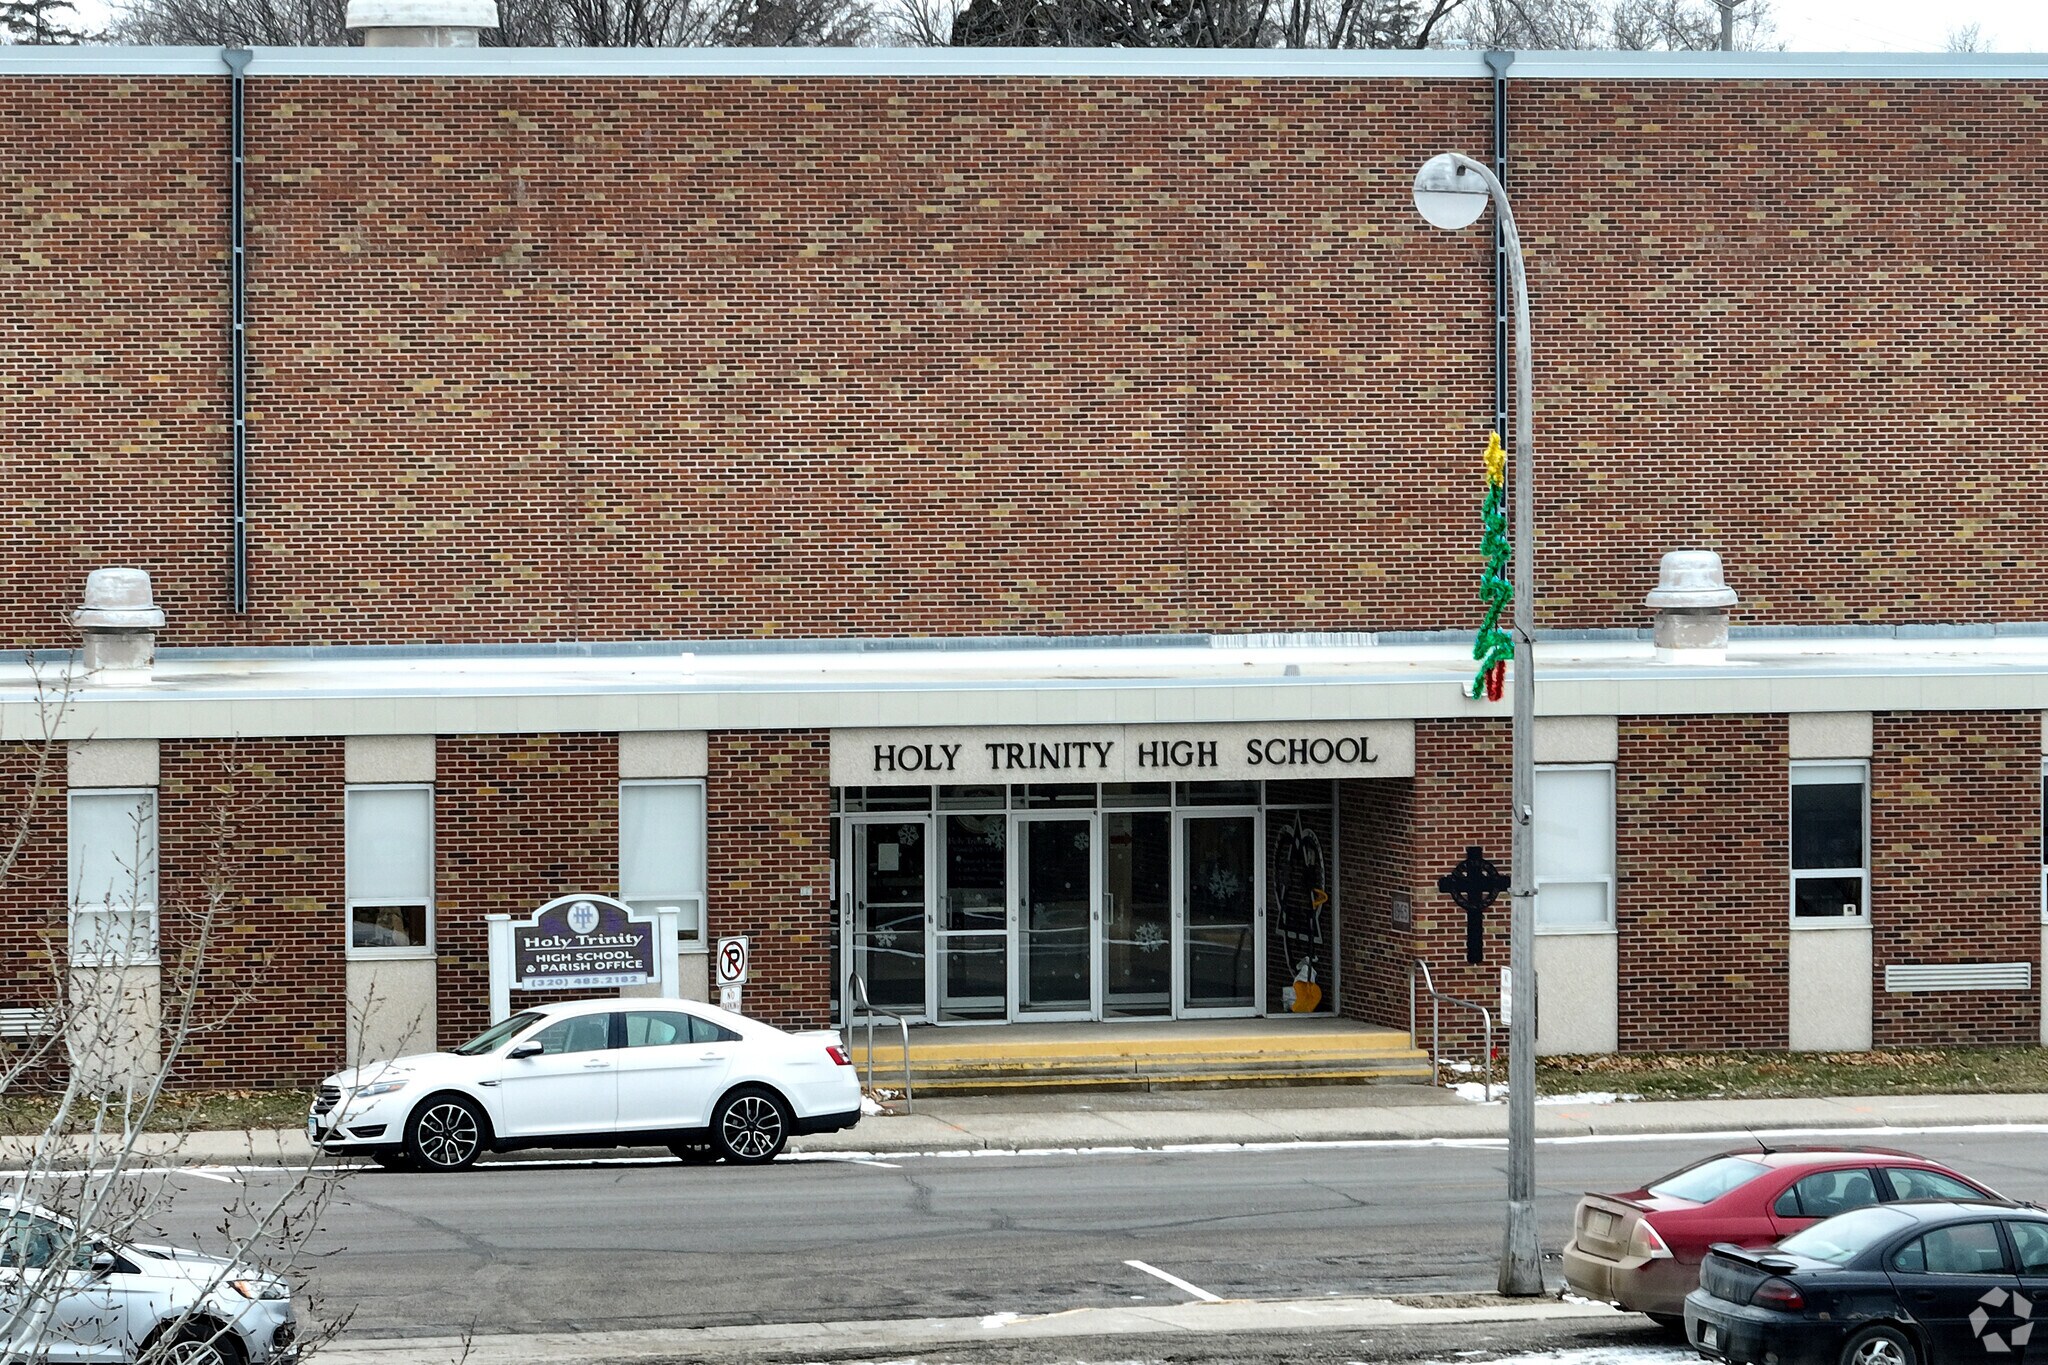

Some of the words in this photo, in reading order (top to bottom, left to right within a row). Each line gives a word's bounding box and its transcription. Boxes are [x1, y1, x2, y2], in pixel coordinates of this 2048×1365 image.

[873, 744, 962, 772] HOLY
[985, 741, 1114, 770] TRINITY
[1138, 740, 1218, 768] HIGH
[1246, 736, 1379, 765] SCHOOL
[523, 935, 572, 950] Holy
[575, 932, 643, 947] Trinity
[535, 953, 572, 963] HIGH
[575, 950, 634, 961] SCHOOL
[727, 948, 740, 973] P
[525, 964, 536, 974] &
[540, 961, 591, 973] PARISH
[594, 959, 643, 970] OFFICE
[531, 977, 569, 987] (320)
